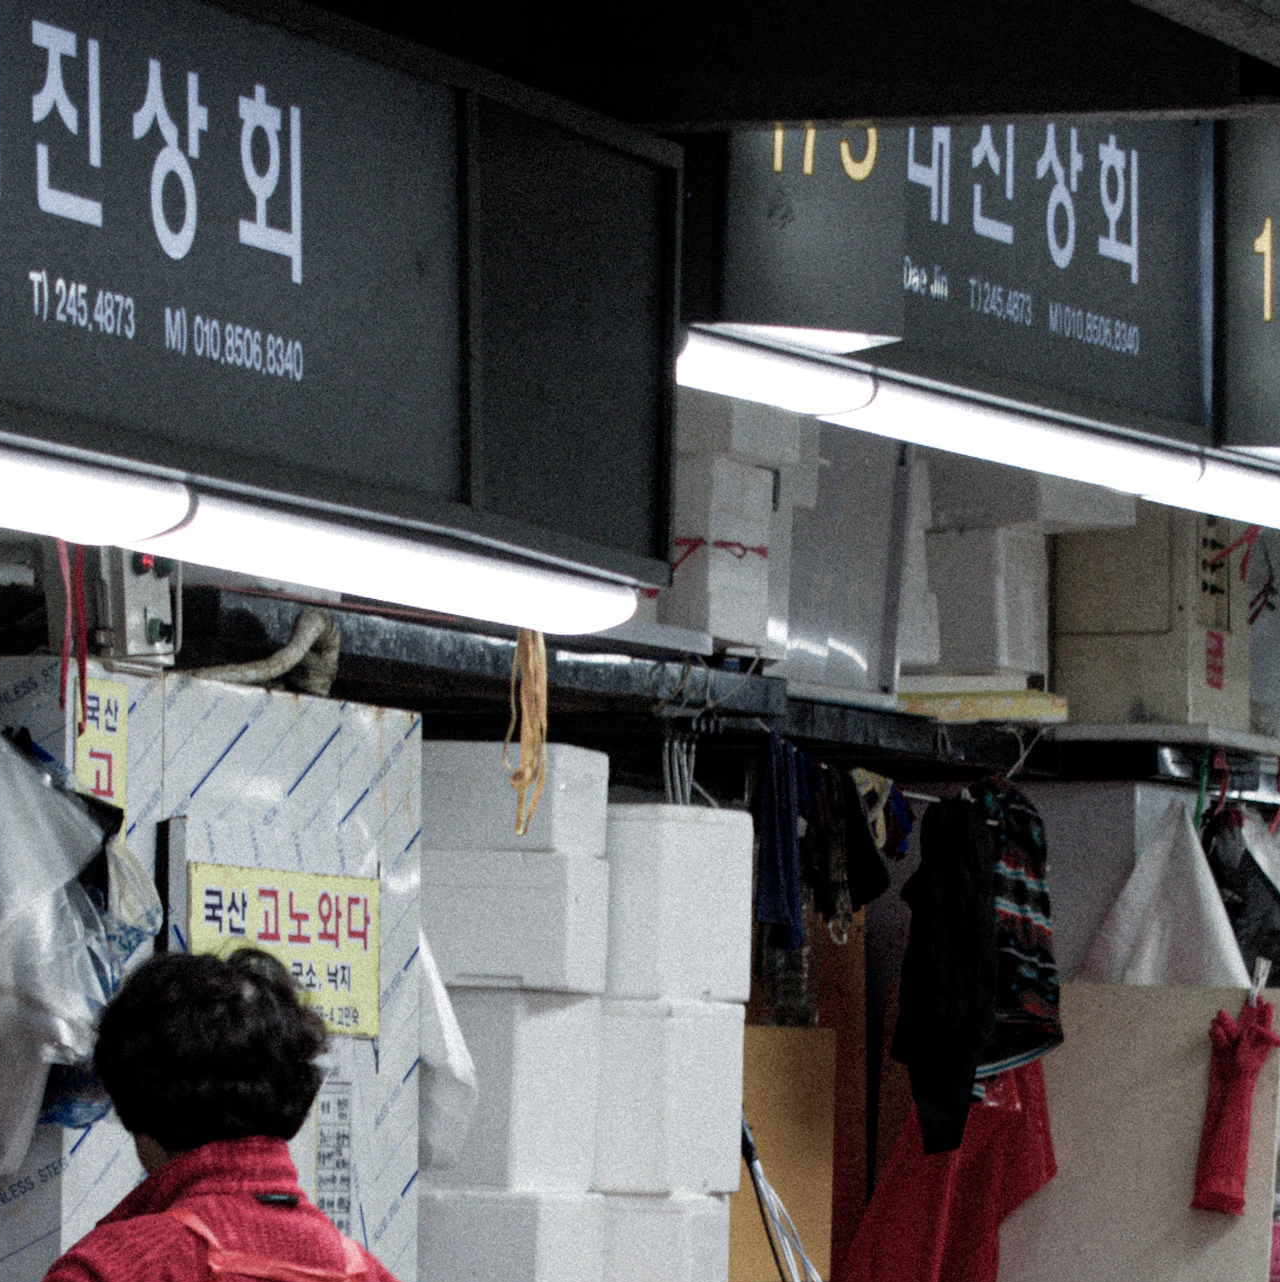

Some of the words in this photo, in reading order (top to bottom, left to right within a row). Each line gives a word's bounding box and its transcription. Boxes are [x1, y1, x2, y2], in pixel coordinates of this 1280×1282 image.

[903, 254, 928, 297] Dae
[28, 269, 49, 322] T)
[55, 276, 136, 341] 245.4873
[164, 306, 188, 356] M)
[193, 314, 304, 382] 010.8506.8340
[89, 749, 114, 797] 고
[204, 887, 247, 935] 국산
[257, 887, 370, 952] 고노와다
[327, 963, 352, 993] 낙지
